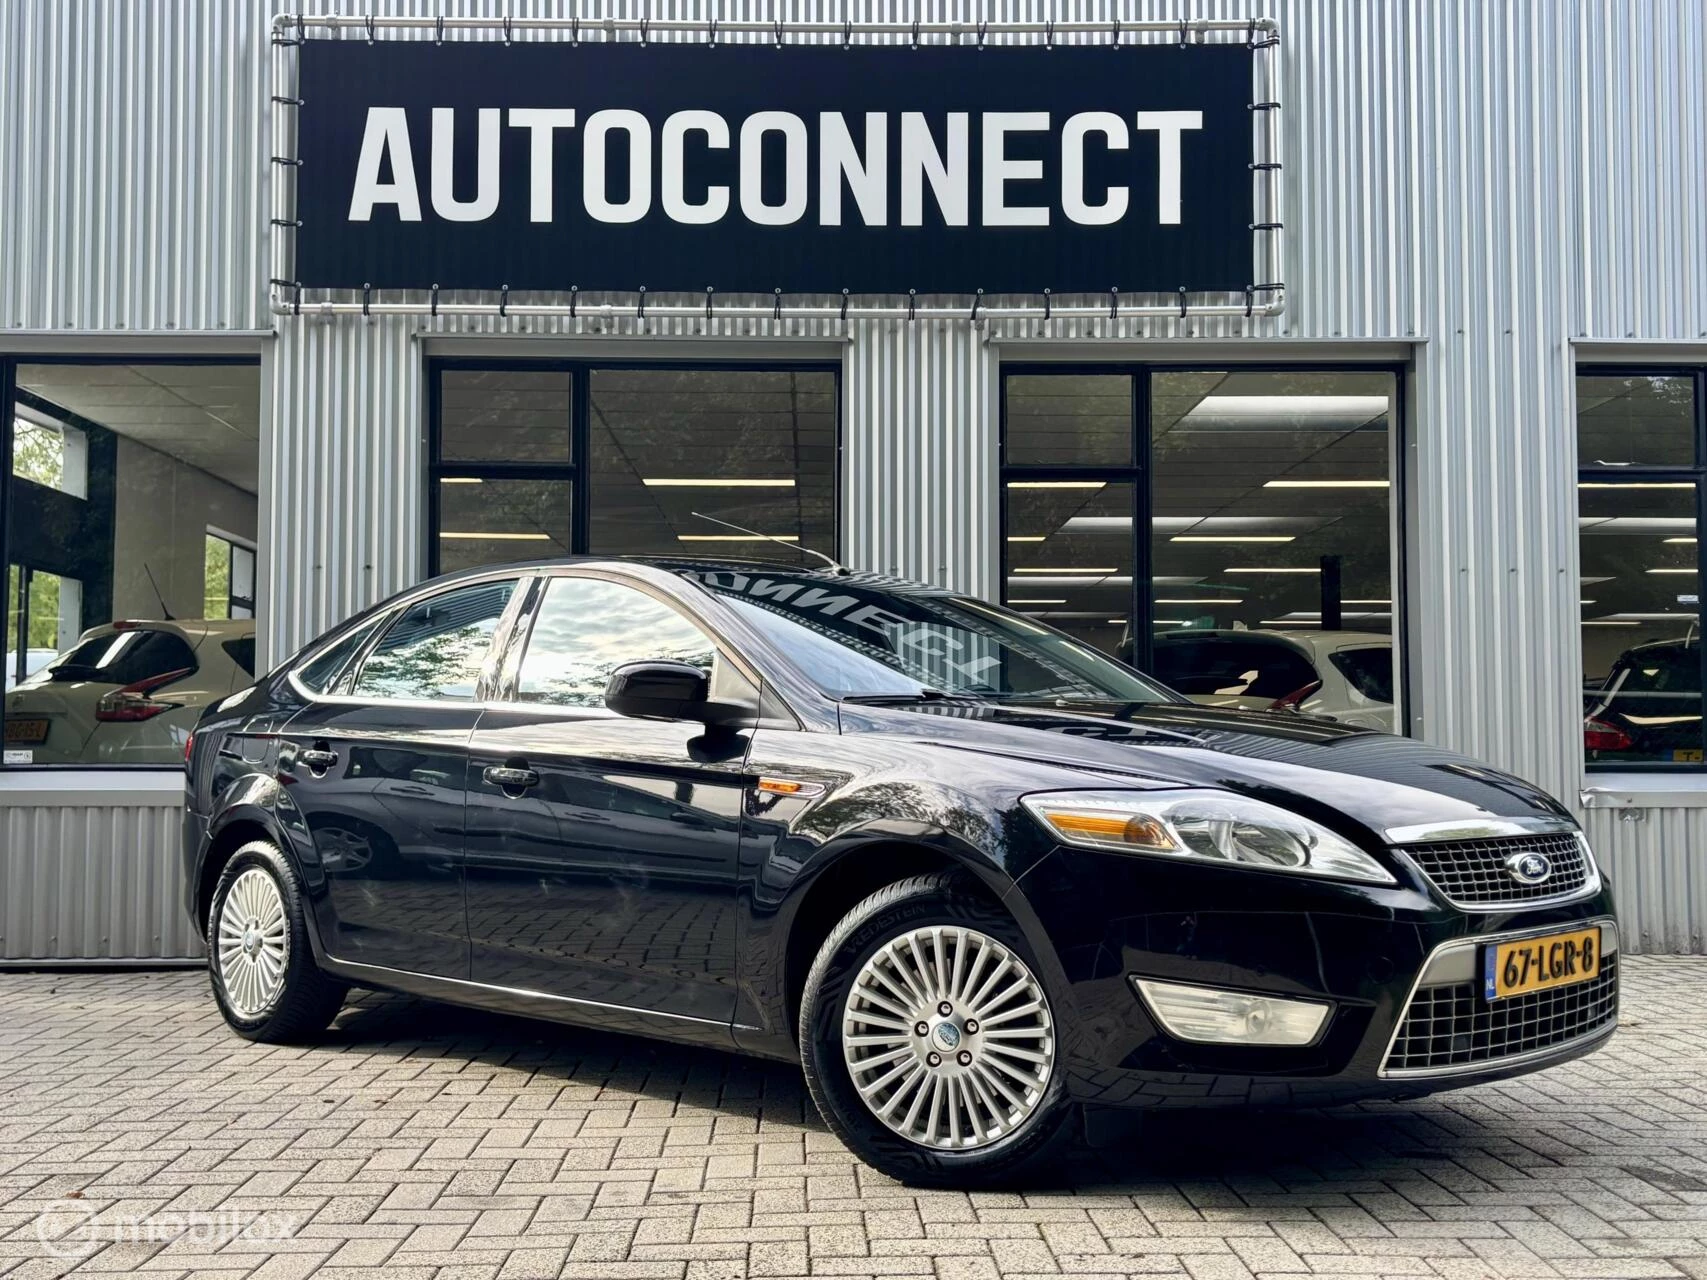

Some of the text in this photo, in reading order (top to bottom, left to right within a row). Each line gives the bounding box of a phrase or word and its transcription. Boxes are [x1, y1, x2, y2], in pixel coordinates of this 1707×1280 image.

[347, 106, 1203, 227] AUTOCONNECT
[844, 903, 926, 954] VREDESTEIN
[1503, 935, 1594, 988] 67-LGR-8
